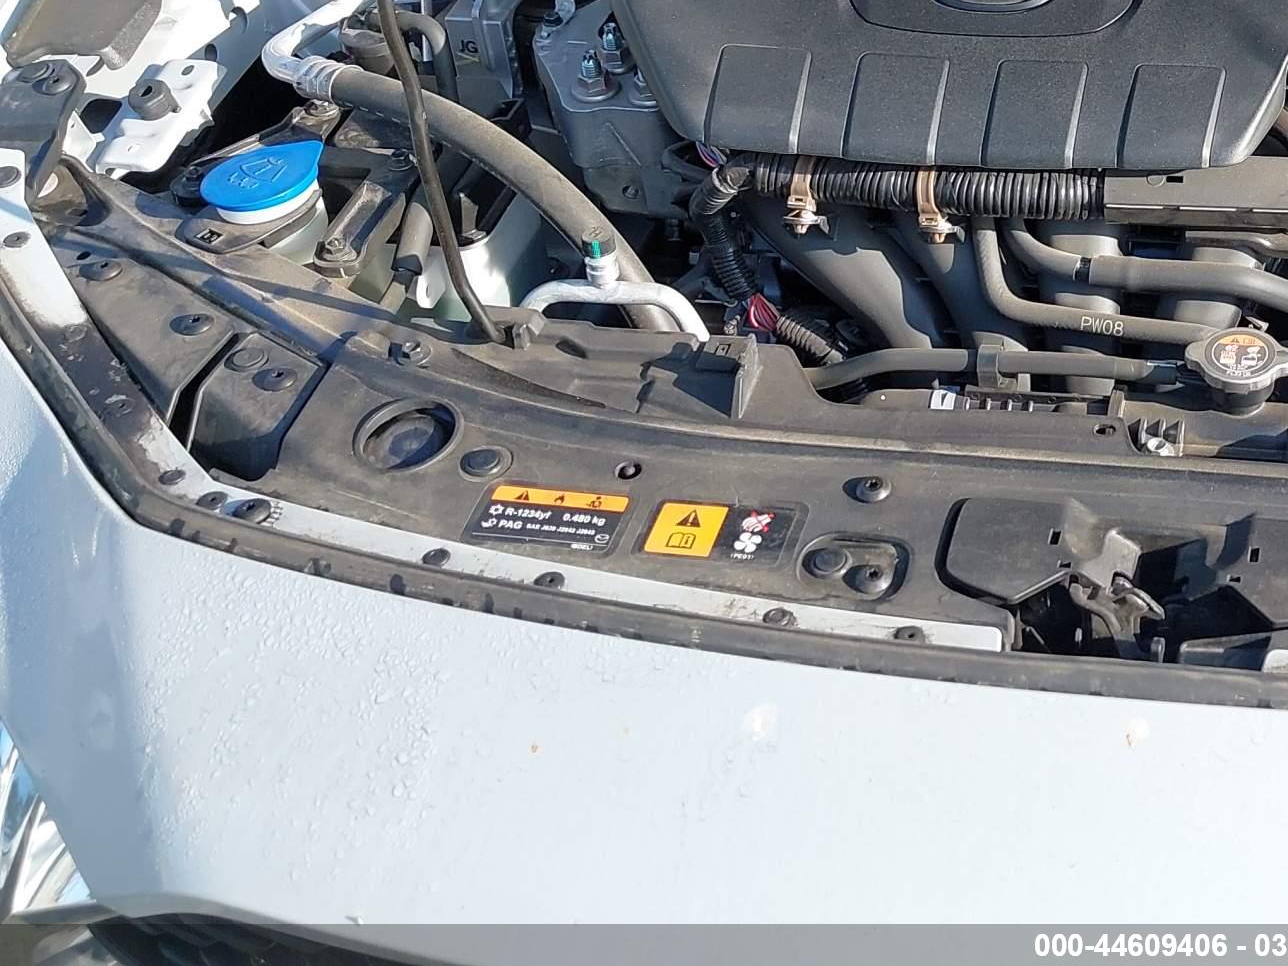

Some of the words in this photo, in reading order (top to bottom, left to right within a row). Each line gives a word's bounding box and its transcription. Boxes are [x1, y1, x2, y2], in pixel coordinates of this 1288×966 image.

[1080, 315, 1124, 337] PW08
[498, 519, 523, 530] PAG
[504, 506, 553, 521] R-1234yf
[591, 514, 606, 527] kg
